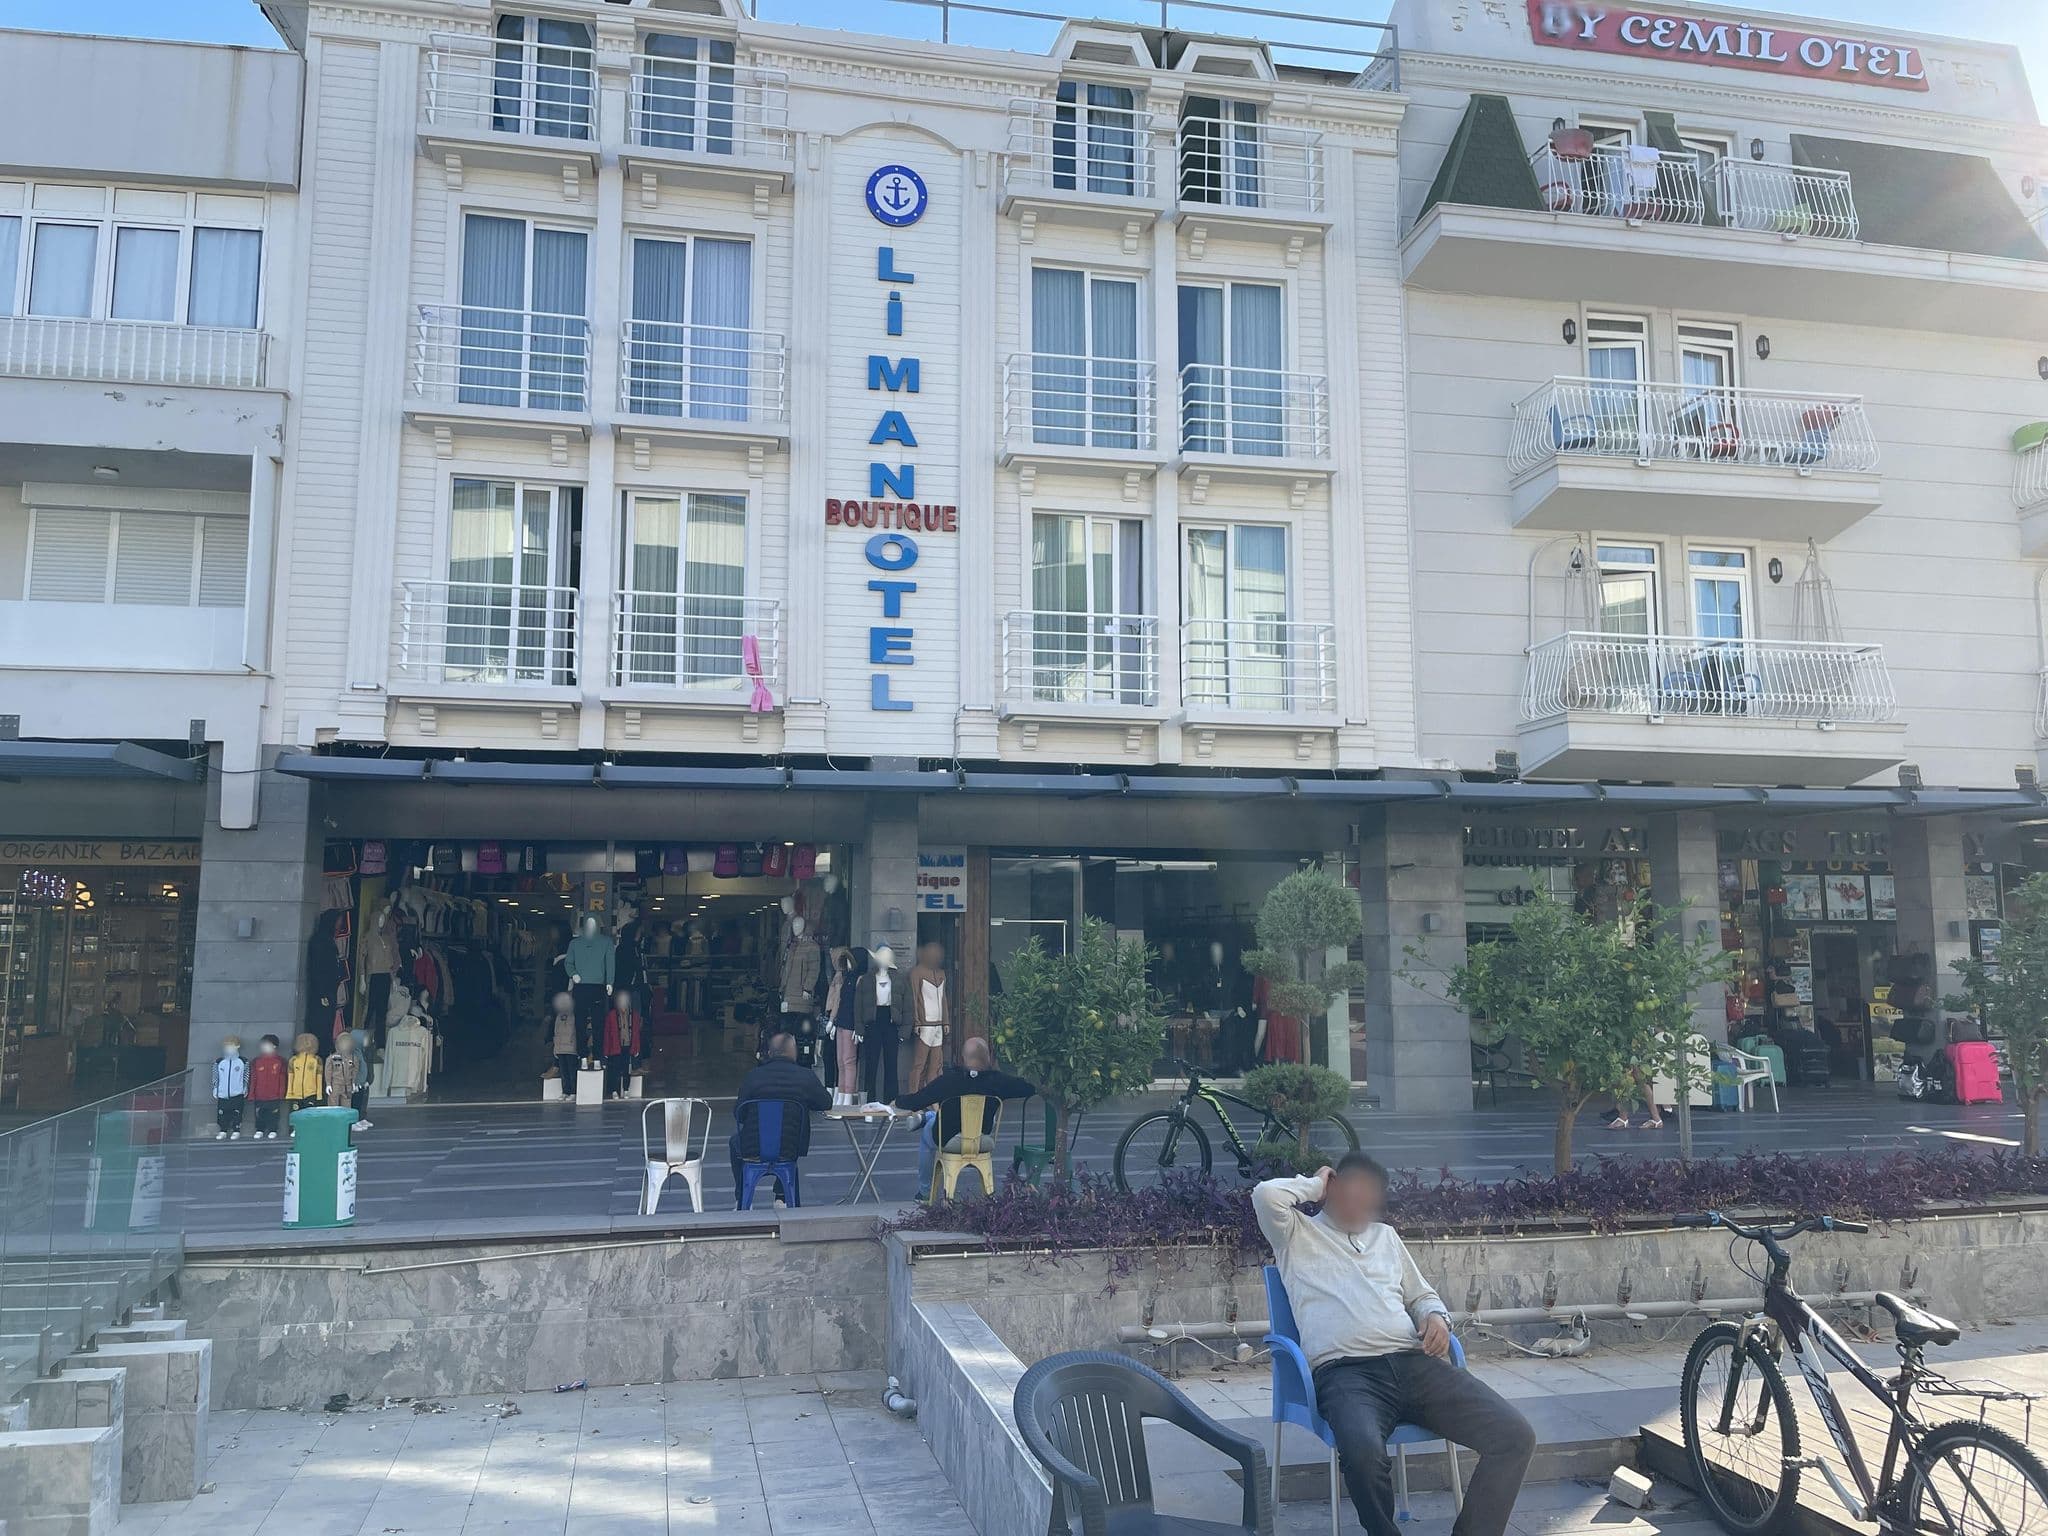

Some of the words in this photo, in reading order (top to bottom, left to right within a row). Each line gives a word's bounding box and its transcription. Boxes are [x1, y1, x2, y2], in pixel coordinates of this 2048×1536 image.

[1799, 36, 1925, 80] OTEL
[825, 498, 958, 533] BOUTIQUE
[864, 533, 919, 711] OTEL
